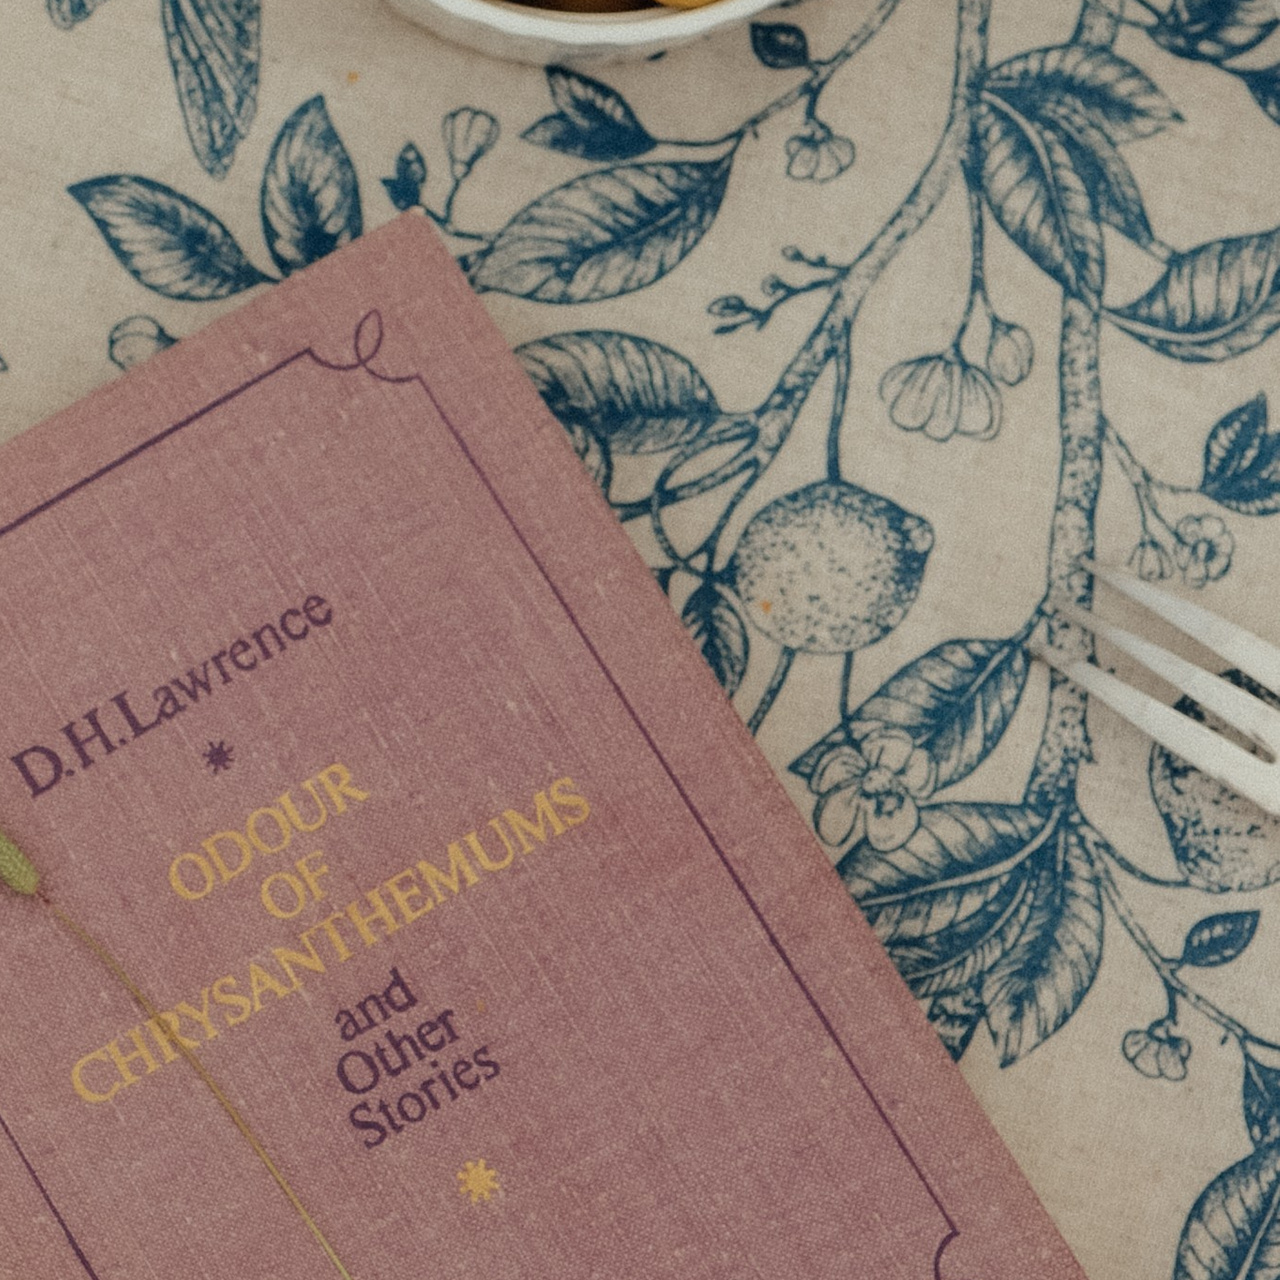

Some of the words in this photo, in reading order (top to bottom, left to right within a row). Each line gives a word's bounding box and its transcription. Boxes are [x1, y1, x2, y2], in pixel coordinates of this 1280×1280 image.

[10, 594, 333, 797] D.H.Lawrence
[169, 763, 370, 901] ODOUR
[260, 851, 329, 918] OF
[70, 776, 591, 1104] CHRYSANTHEMUMS
[334, 968, 417, 1042] and
[336, 1009, 460, 1096] Other
[348, 1044, 500, 1150] Stories
